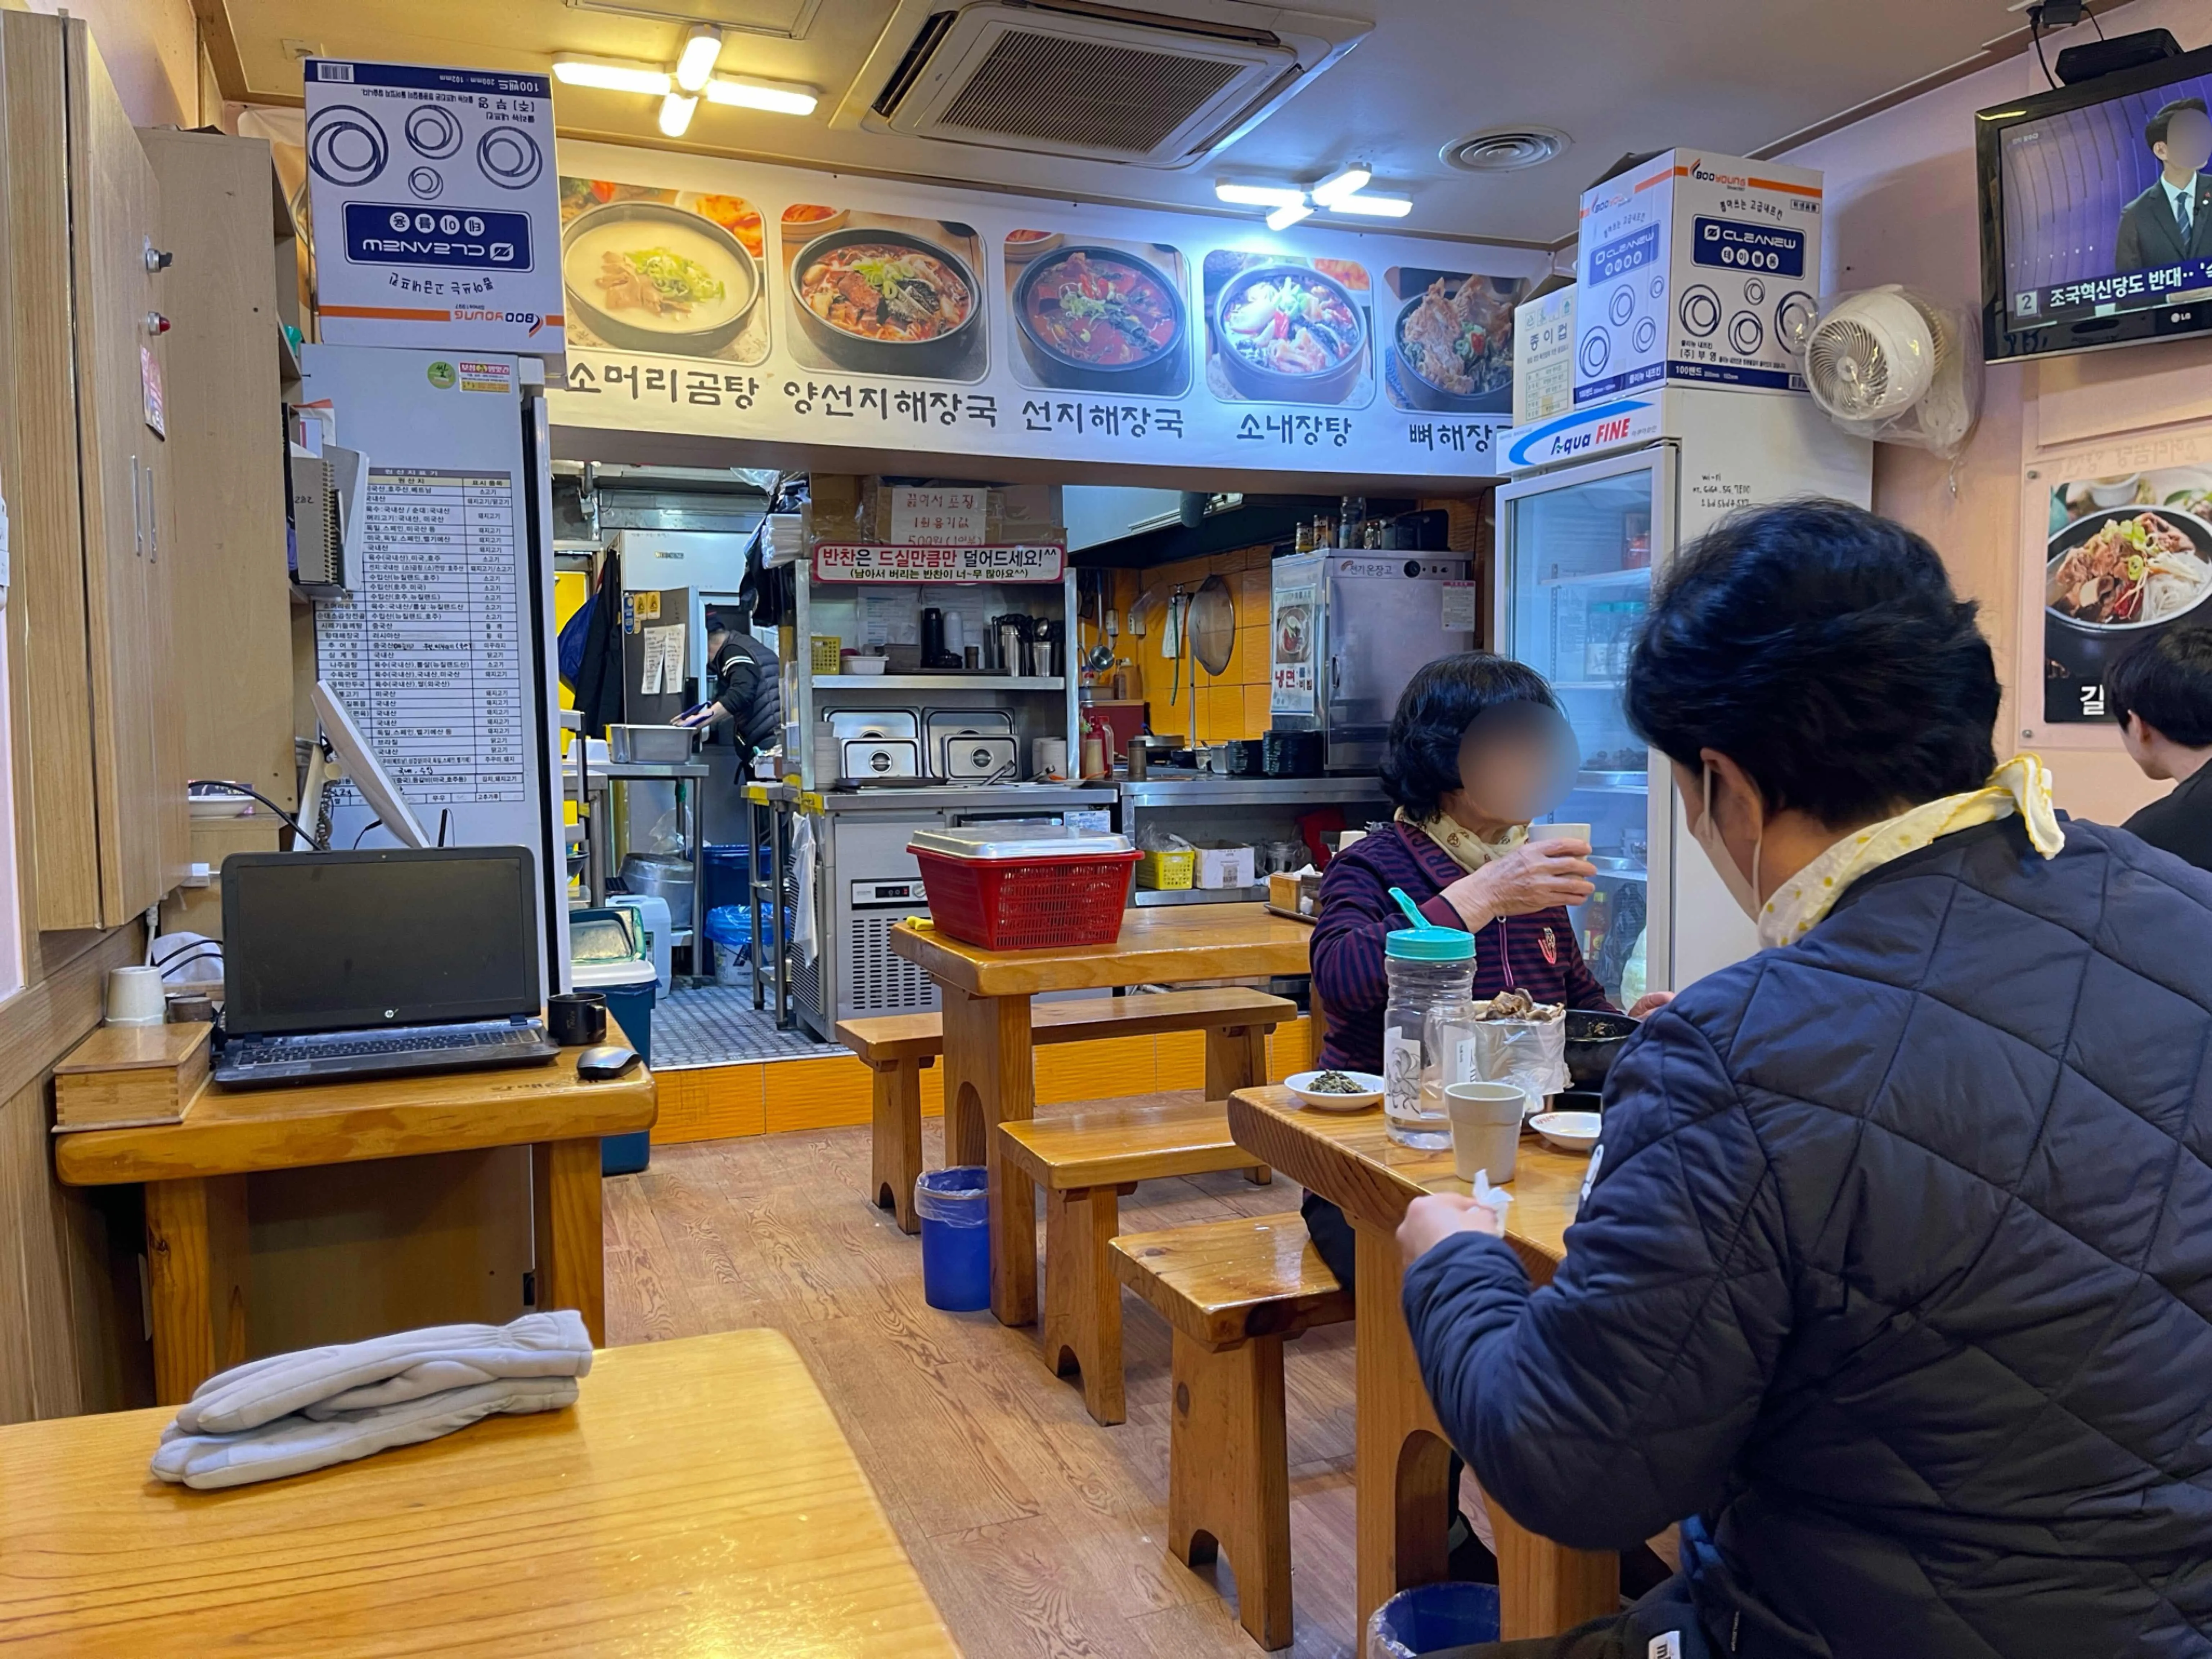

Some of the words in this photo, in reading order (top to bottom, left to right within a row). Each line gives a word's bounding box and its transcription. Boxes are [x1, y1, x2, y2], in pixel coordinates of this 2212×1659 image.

[362, 239, 485, 257] CLEANEW
[1722, 230, 1796, 249] CLEANEW
[2022, 295, 2032, 310] 2
[2050, 274, 2143, 307] 조국혁신당도
[2180, 312, 2191, 320] LG
[569, 361, 760, 410] 소머리곰탕
[784, 381, 998, 428] 양선지해장국
[1022, 400, 1184, 440] 선지해장국
[1236, 413, 1353, 448] 소내장탕
[1408, 423, 1512, 452] 뼈해장
[1551, 433, 1591, 455] Aqua
[1595, 418, 1631, 444] FINE
[823, 548, 872, 568] 반찬은
[878, 549, 957, 567] 드실만큼만
[850, 568, 885, 579] (남아서
[889, 569, 920, 579] 버리는
[923, 569, 953, 579] 반찬이
[956, 569, 983, 579] 너~무
